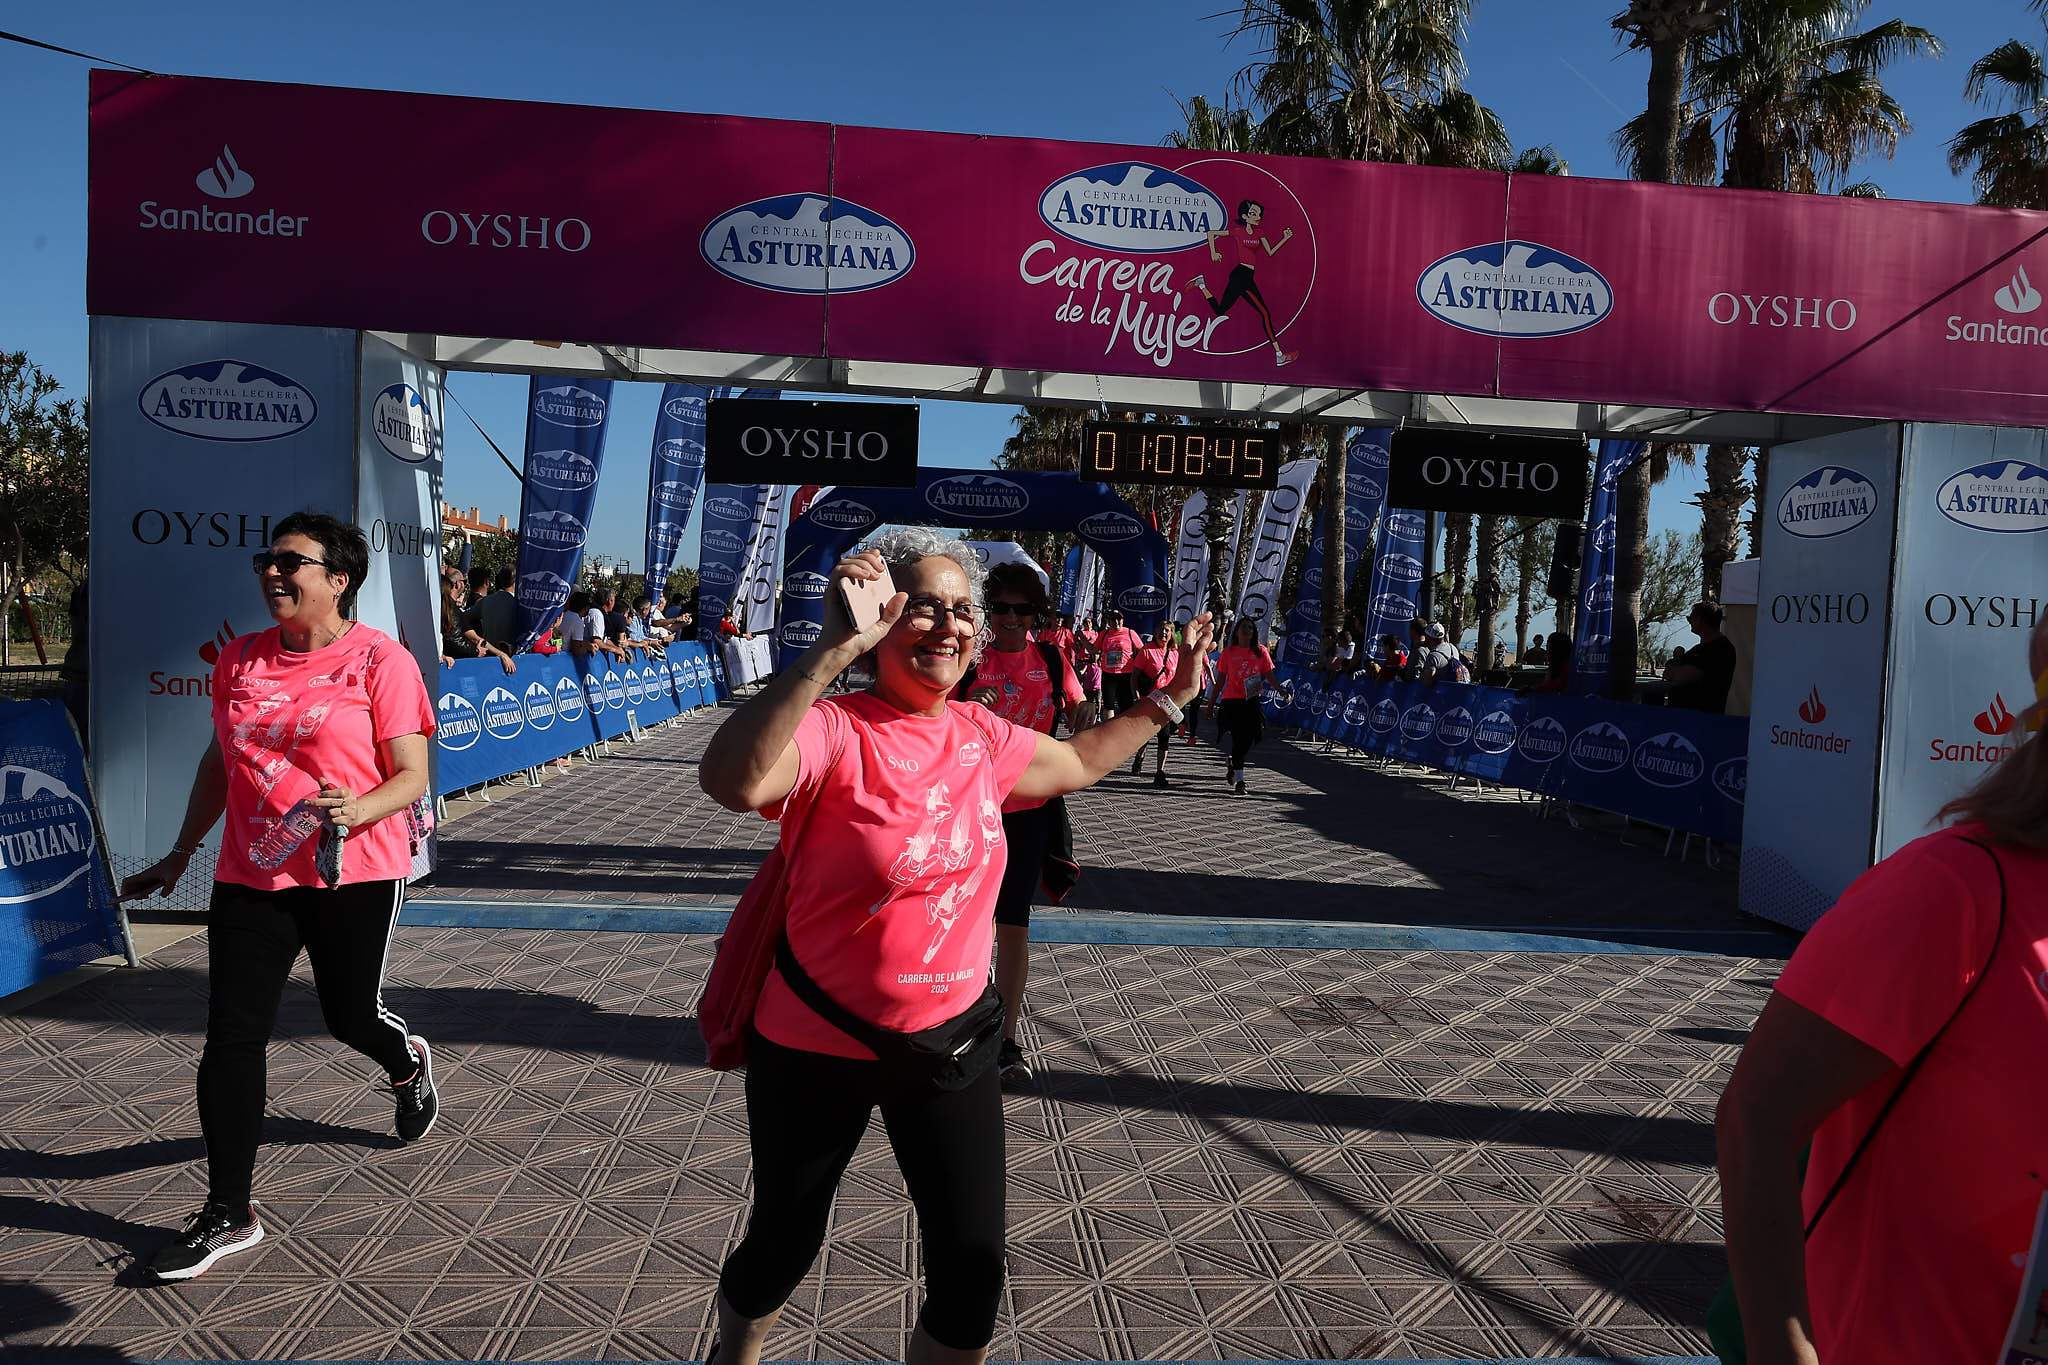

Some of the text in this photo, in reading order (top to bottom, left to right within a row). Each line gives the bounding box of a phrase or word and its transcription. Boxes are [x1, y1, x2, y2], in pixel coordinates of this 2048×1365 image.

[1053, 190, 1211, 233] ASTURIANA
[1083, 189, 1208, 208] CENTRAL LECHERA
[139, 200, 309, 237] Santander
[421, 210, 592, 252] OYSHO
[751, 225, 817, 239] CENTRAL
[716, 225, 898, 271] ASTURIANA
[1019, 239, 1173, 295] Carrera
[1463, 271, 1593, 288] CENTRAL LECHERA
[1431, 271, 1597, 316] ASTURIANA
[1708, 292, 1857, 331] OYSHO
[1055, 291, 1229, 367] de la Mujer
[152, 387, 304, 424] ASTURIANA
[180, 386, 299, 400] CENTRAL LECHERA
[536, 396, 602, 420] ASTURIANA
[377, 403, 432, 449] ASTURIANA
[741, 426, 889, 462] OYSHO
[1095, 431, 1264, 478] 01:08:45
[530, 459, 592, 483] ASTURIANA
[1422, 456, 1559, 492] OYSHO
[933, 485, 1021, 508] ASTURIANA
[1797, 491, 1829, 501] CENTRAL
[1969, 483, 2014, 493] CENTRAL
[814, 508, 870, 523] ASTURIANA
[1782, 496, 1869, 524] ASTURIANA
[132, 509, 271, 548] OYSH
[371, 518, 434, 558] OYSHO
[1084, 522, 1140, 534] ASTURIANA
[1241, 485, 1300, 621] OYSHO
[1771, 592, 1869, 625] OYSHO
[1925, 593, 2048, 628] OYSH
[150, 671, 213, 697] Sant
[486, 708, 522, 729] ASTURIANA
[528, 700, 554, 720] ASTURIANA
[437, 718, 479, 740] ASTURIANA
[1520, 731, 1561, 752] ASTURIANA
[1771, 724, 1851, 755] Santander
[1573, 738, 1624, 763] ASTURIANA
[1637, 748, 1694, 778] ASTURIANA
[31, 803, 75, 821] LECHER
[0, 822, 87, 870] TURIAN
[897, 973, 933, 984] CARRERA
[934, 972, 945, 983] DE
[946, 971, 955, 982] LA
[930, 984, 949, 994] 2024
